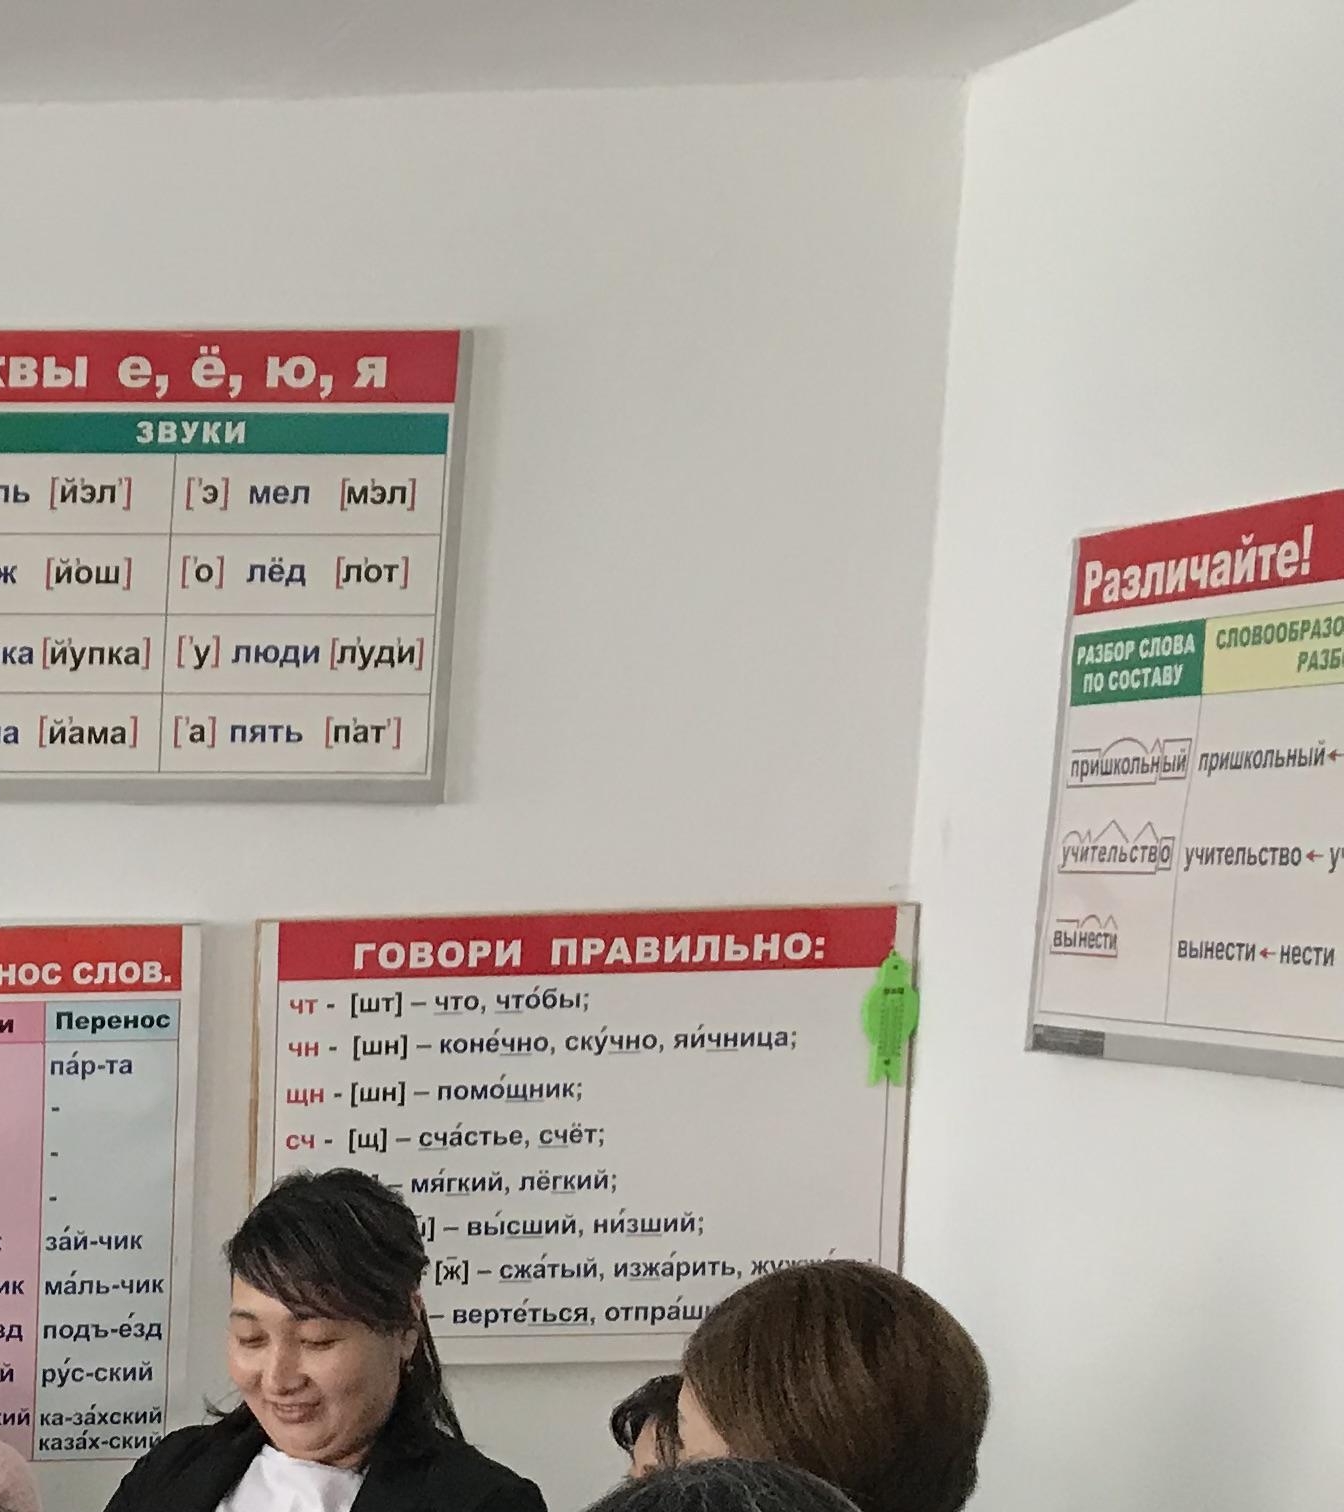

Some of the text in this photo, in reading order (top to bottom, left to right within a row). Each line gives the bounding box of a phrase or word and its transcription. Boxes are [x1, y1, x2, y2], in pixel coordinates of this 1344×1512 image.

[118, 353, 169, 397] е,
[192, 346, 243, 397] ё,
[267, 354, 334, 397] ю,
[353, 355, 387, 388] я
[135, 420, 247, 446] ЗВУКИ
[249, 484, 310, 504] мел
[246, 557, 306, 587] лёд
[1083, 524, 1313, 606] Различайте!
[231, 644, 320, 668] люди
[1077, 635, 1195, 666] РАЗБОР СЛОВА
[1297, 648, 1344, 673] РАЗБ
[1083, 664, 1182, 694] ПО СОСТАВУ
[230, 724, 303, 744] пять
[1070, 748, 1187, 783] пришкольный
[1198, 740, 1325, 777] пришкольный
[1061, 842, 1172, 868] учительство
[1183, 843, 1302, 873] учительство
[353, 932, 826, 969] ГОВОРИ ПРАВИЛЬНО:
[1053, 929, 1117, 950] вынести
[1177, 938, 1335, 967] вынести нести
[72, 962, 172, 985] СЛОВ.
[289, 998, 318, 1014] чт
[351, 992, 402, 1018] [шт]
[435, 994, 486, 1014] что,
[55, 1011, 171, 1032] Перенос
[288, 1041, 319, 1057] чн
[353, 1035, 407, 1061] [шн]
[286, 1088, 324, 1105] щн
[351, 1082, 405, 1108] [шн]
[286, 1134, 314, 1150] сч
[349, 1128, 387, 1153] [щ]
[539, 1123, 604, 1148] счёт;
[519, 1169, 617, 1193] лёгкий;
[605, 1295, 715, 1325] отпра́ш
